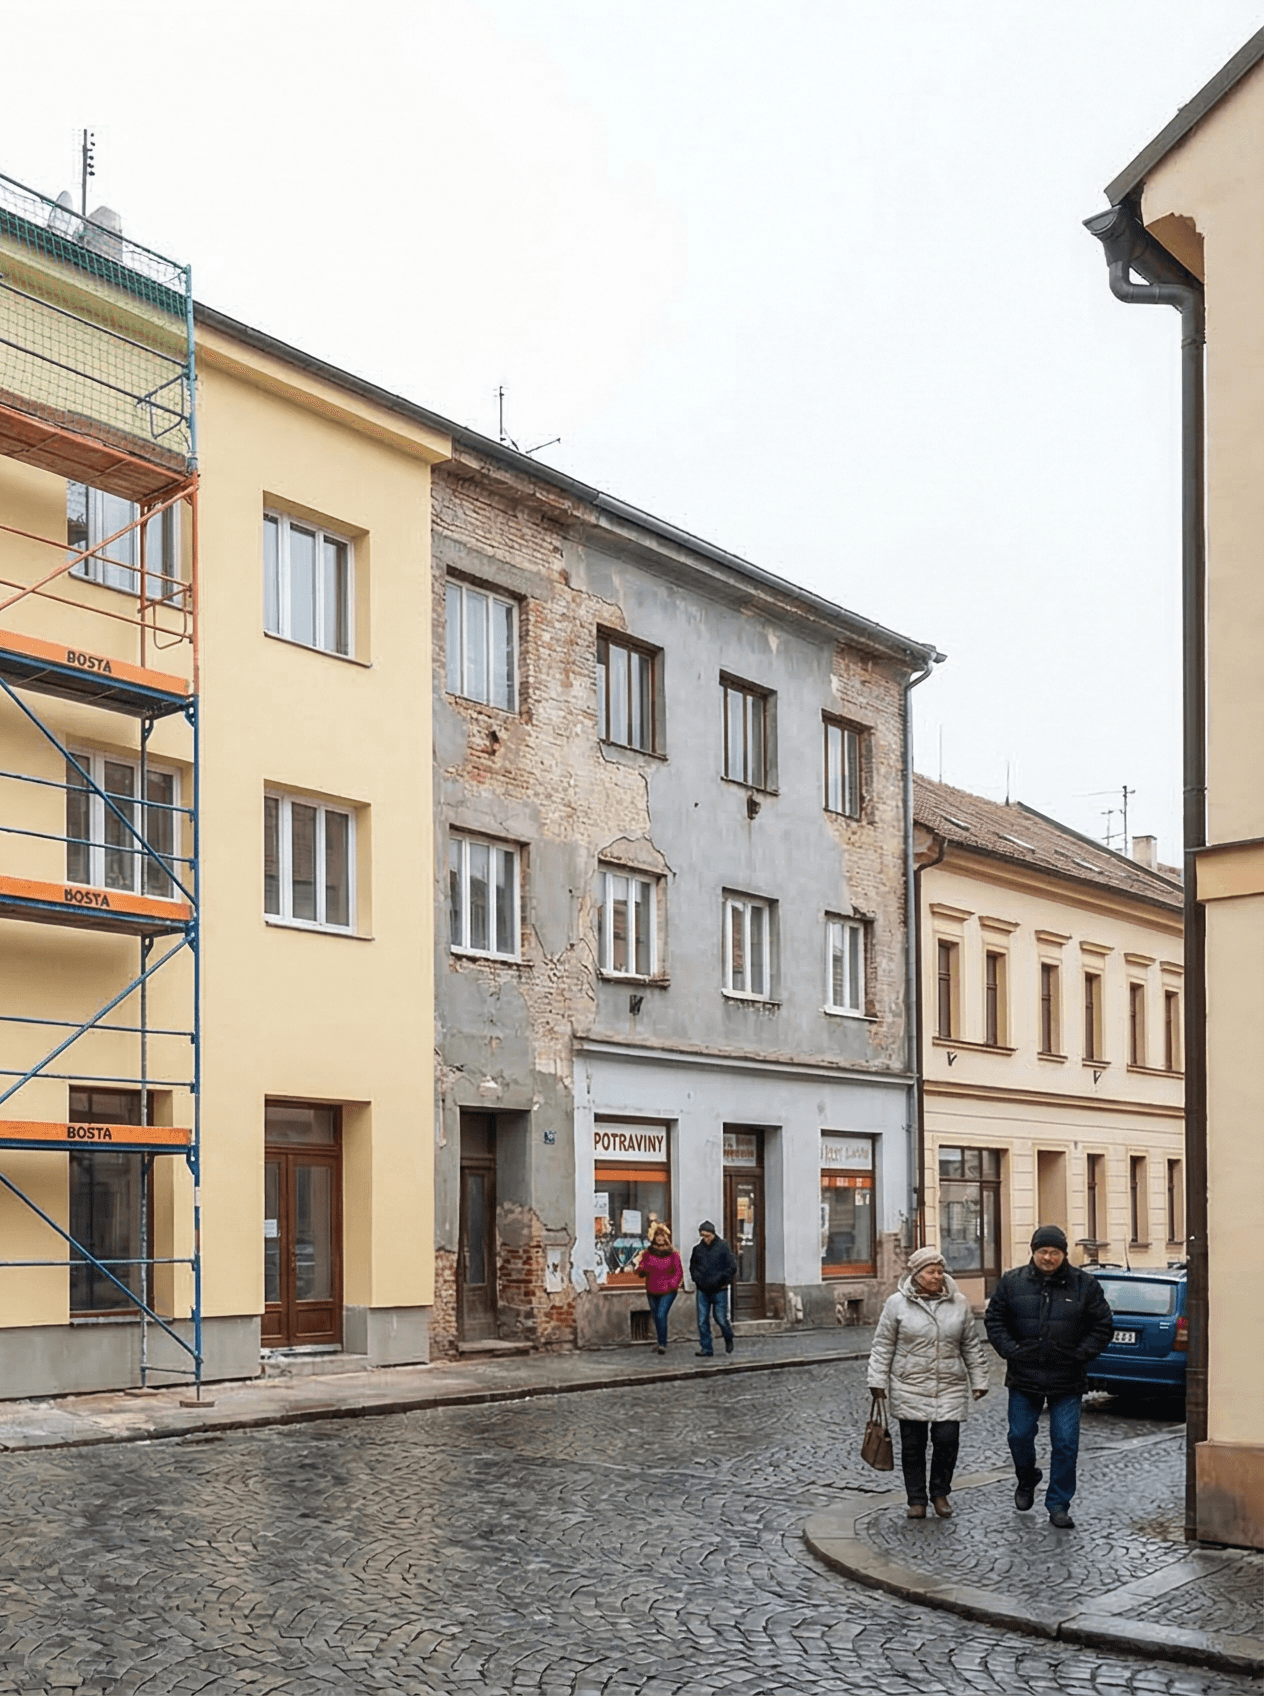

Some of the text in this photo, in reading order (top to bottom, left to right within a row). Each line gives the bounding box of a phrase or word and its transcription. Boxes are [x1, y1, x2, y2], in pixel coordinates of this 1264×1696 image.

[67, 650, 112, 674] BOSTA
[64, 888, 110, 908] BOSTA
[67, 1126, 112, 1140] BOSTA
[594, 1132, 664, 1153] POTRAVINY
